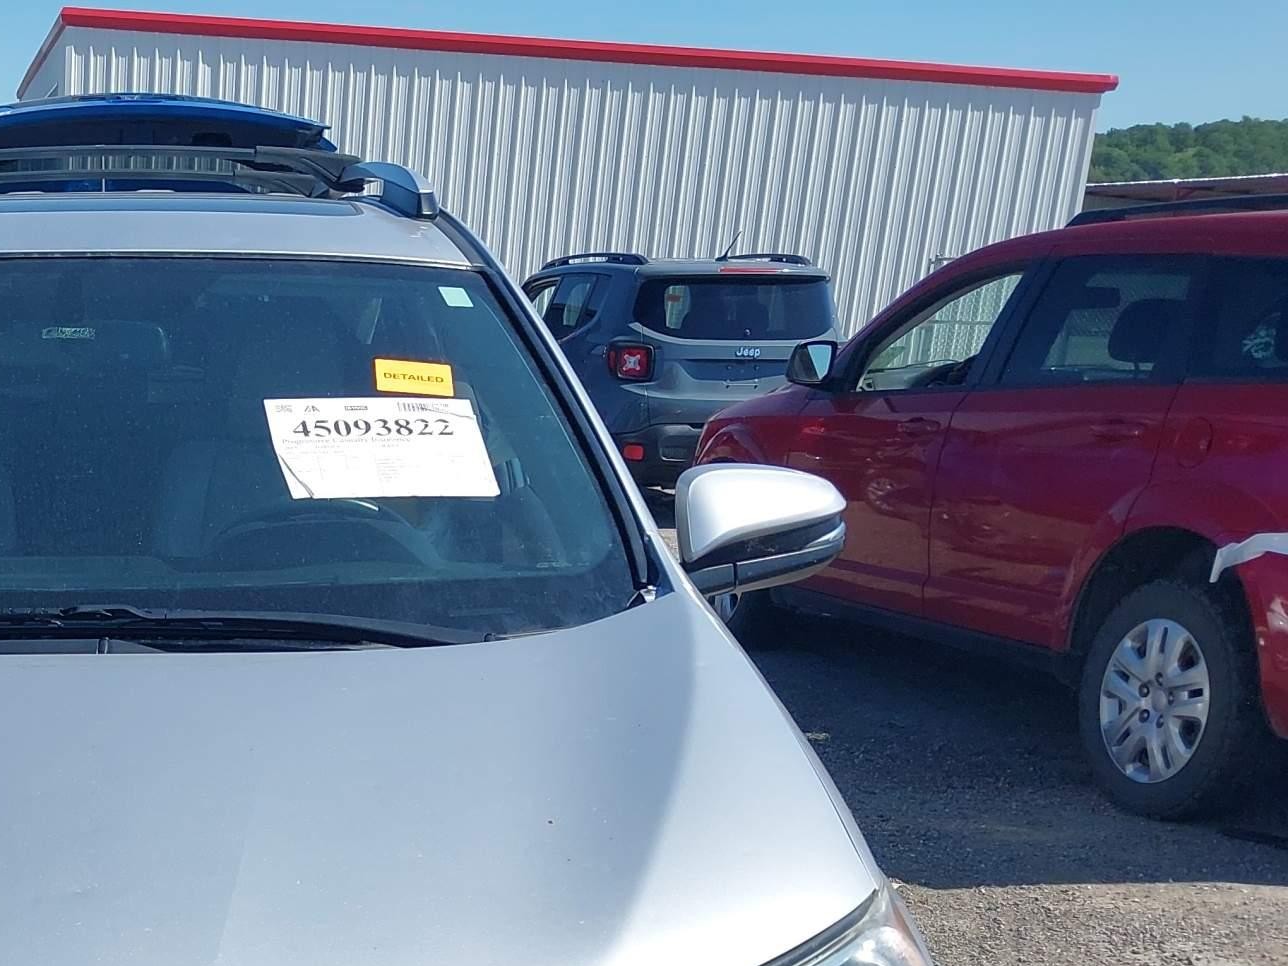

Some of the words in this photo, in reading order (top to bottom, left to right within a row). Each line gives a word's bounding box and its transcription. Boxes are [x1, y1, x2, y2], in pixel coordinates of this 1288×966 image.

[736, 346, 760, 358] Jeep
[383, 372, 444, 383] DETAILED
[292, 418, 454, 437] 45093822
